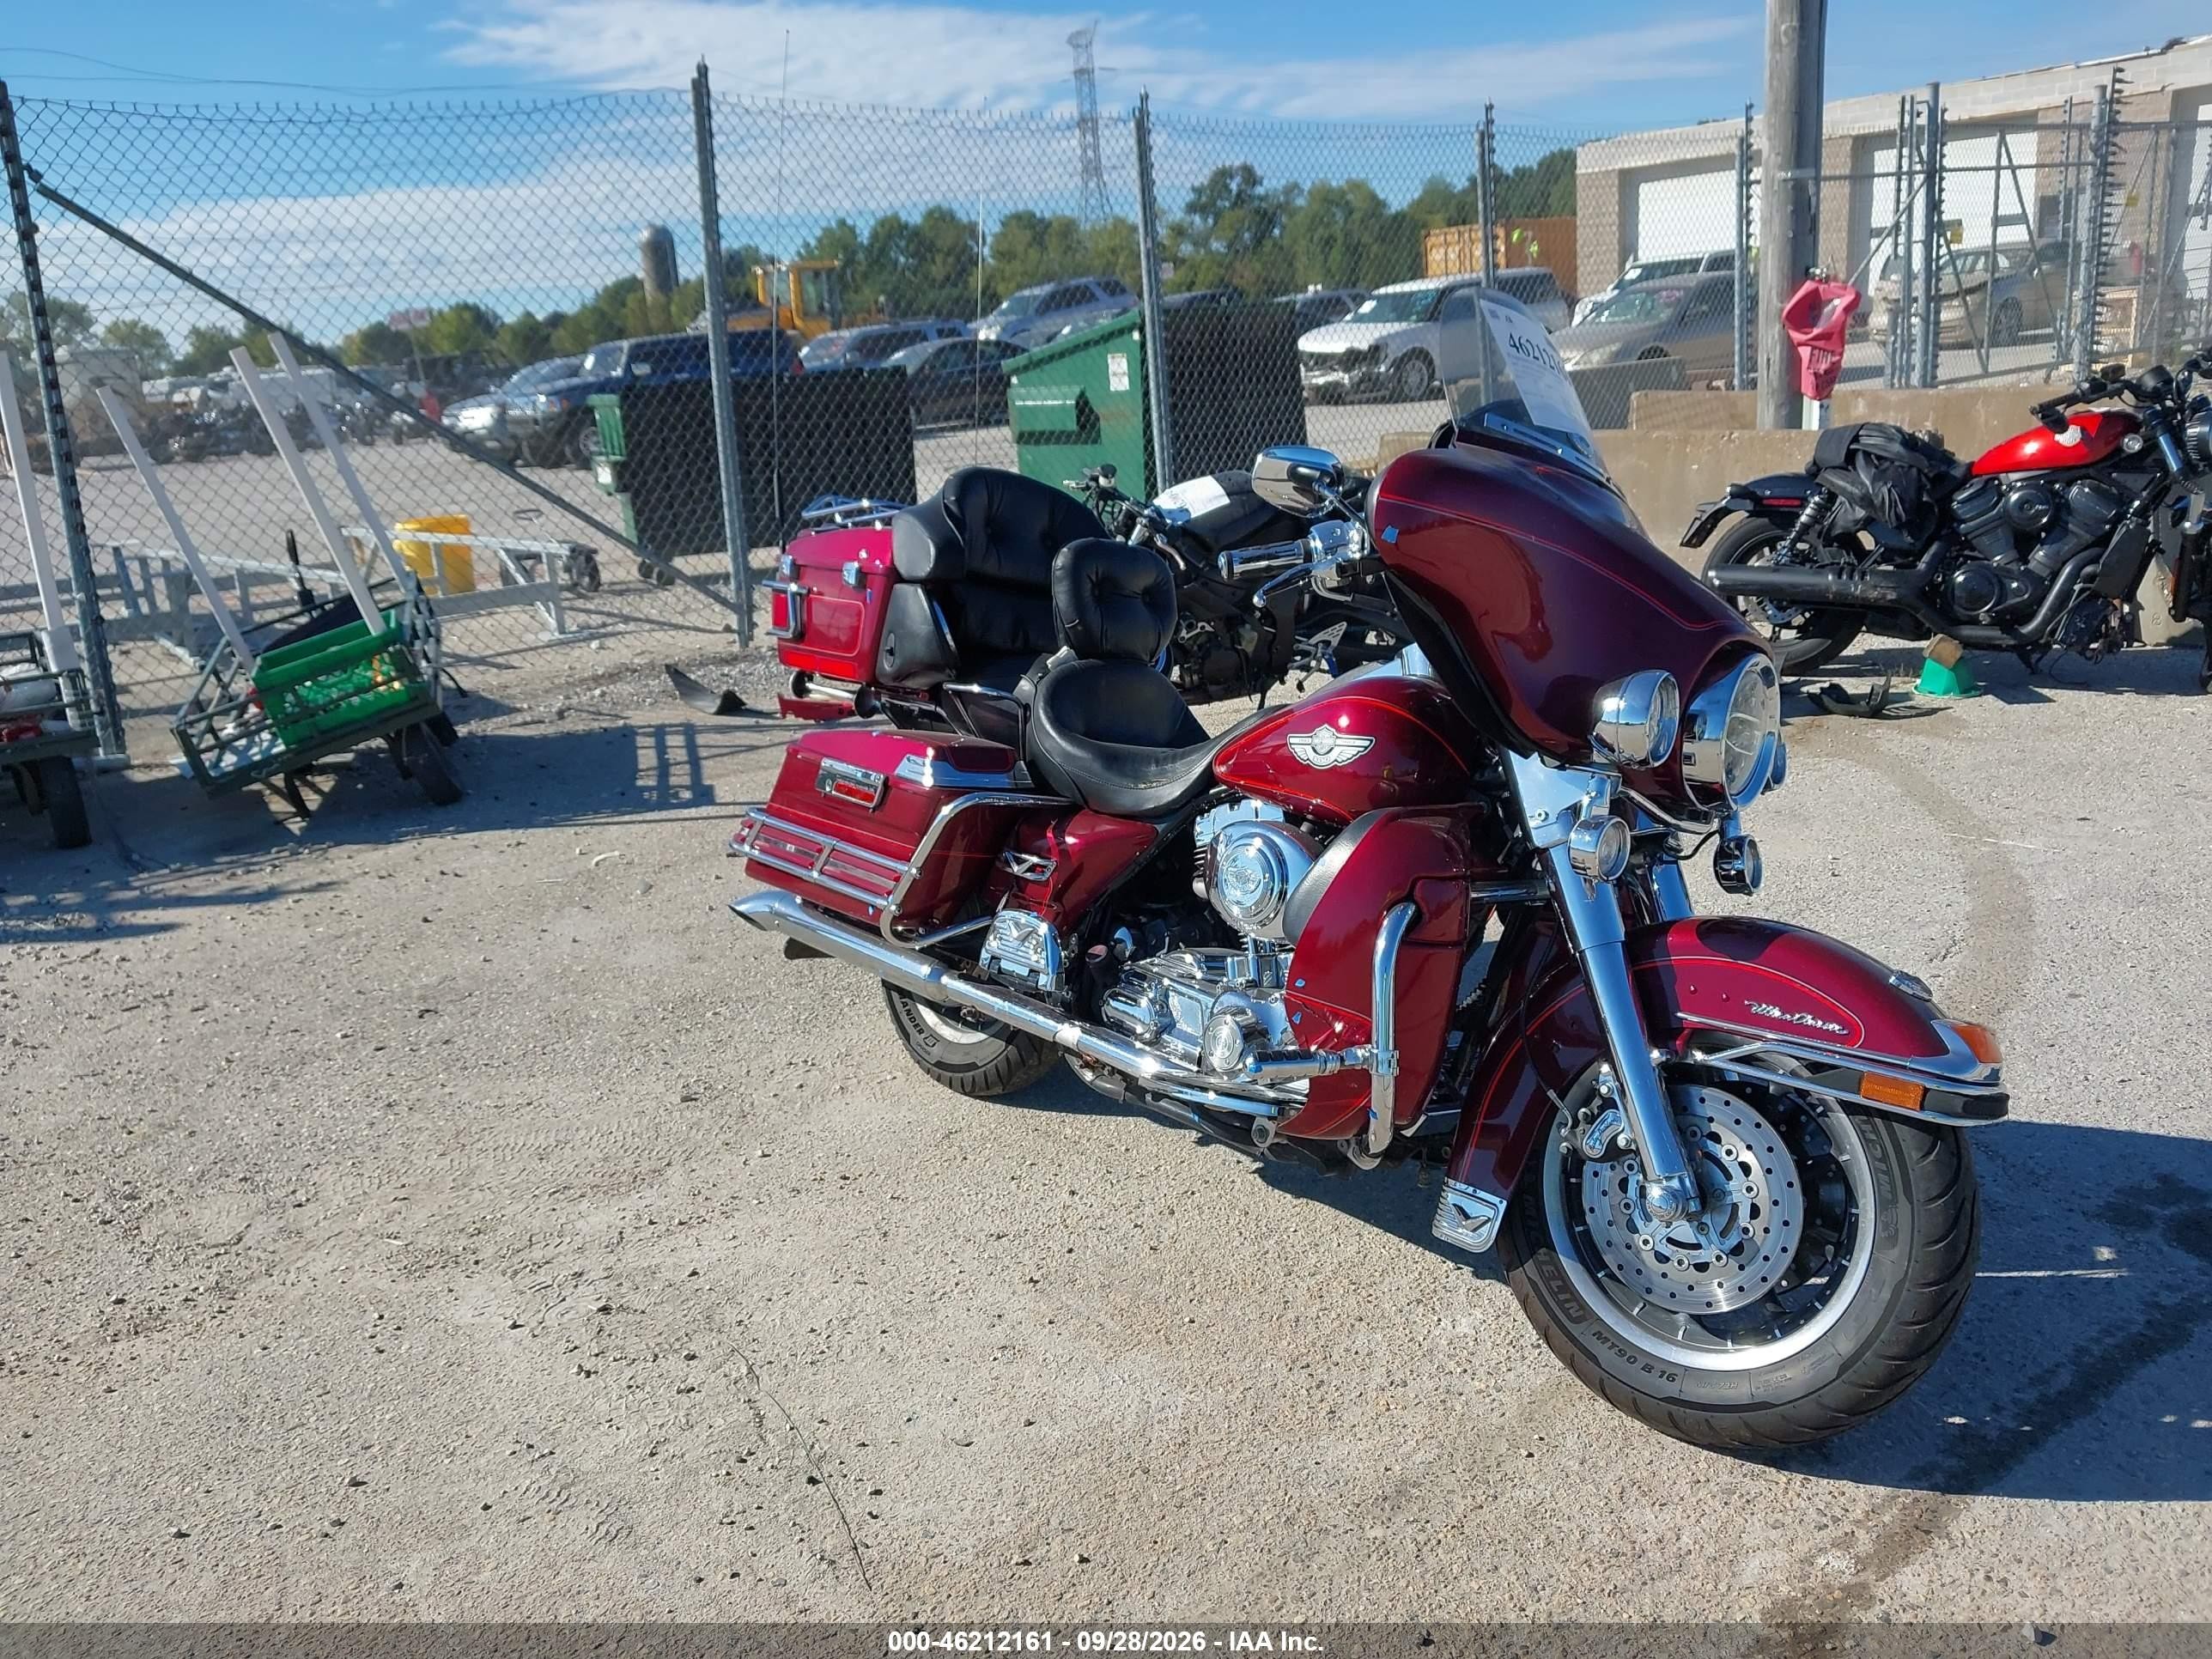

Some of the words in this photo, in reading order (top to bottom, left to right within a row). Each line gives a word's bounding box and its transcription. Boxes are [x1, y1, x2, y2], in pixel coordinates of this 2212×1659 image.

[1590, 1329, 1638, 1366] MT90
[1640, 1362, 1656, 1375] B
[1657, 1369, 1679, 1384] 16
